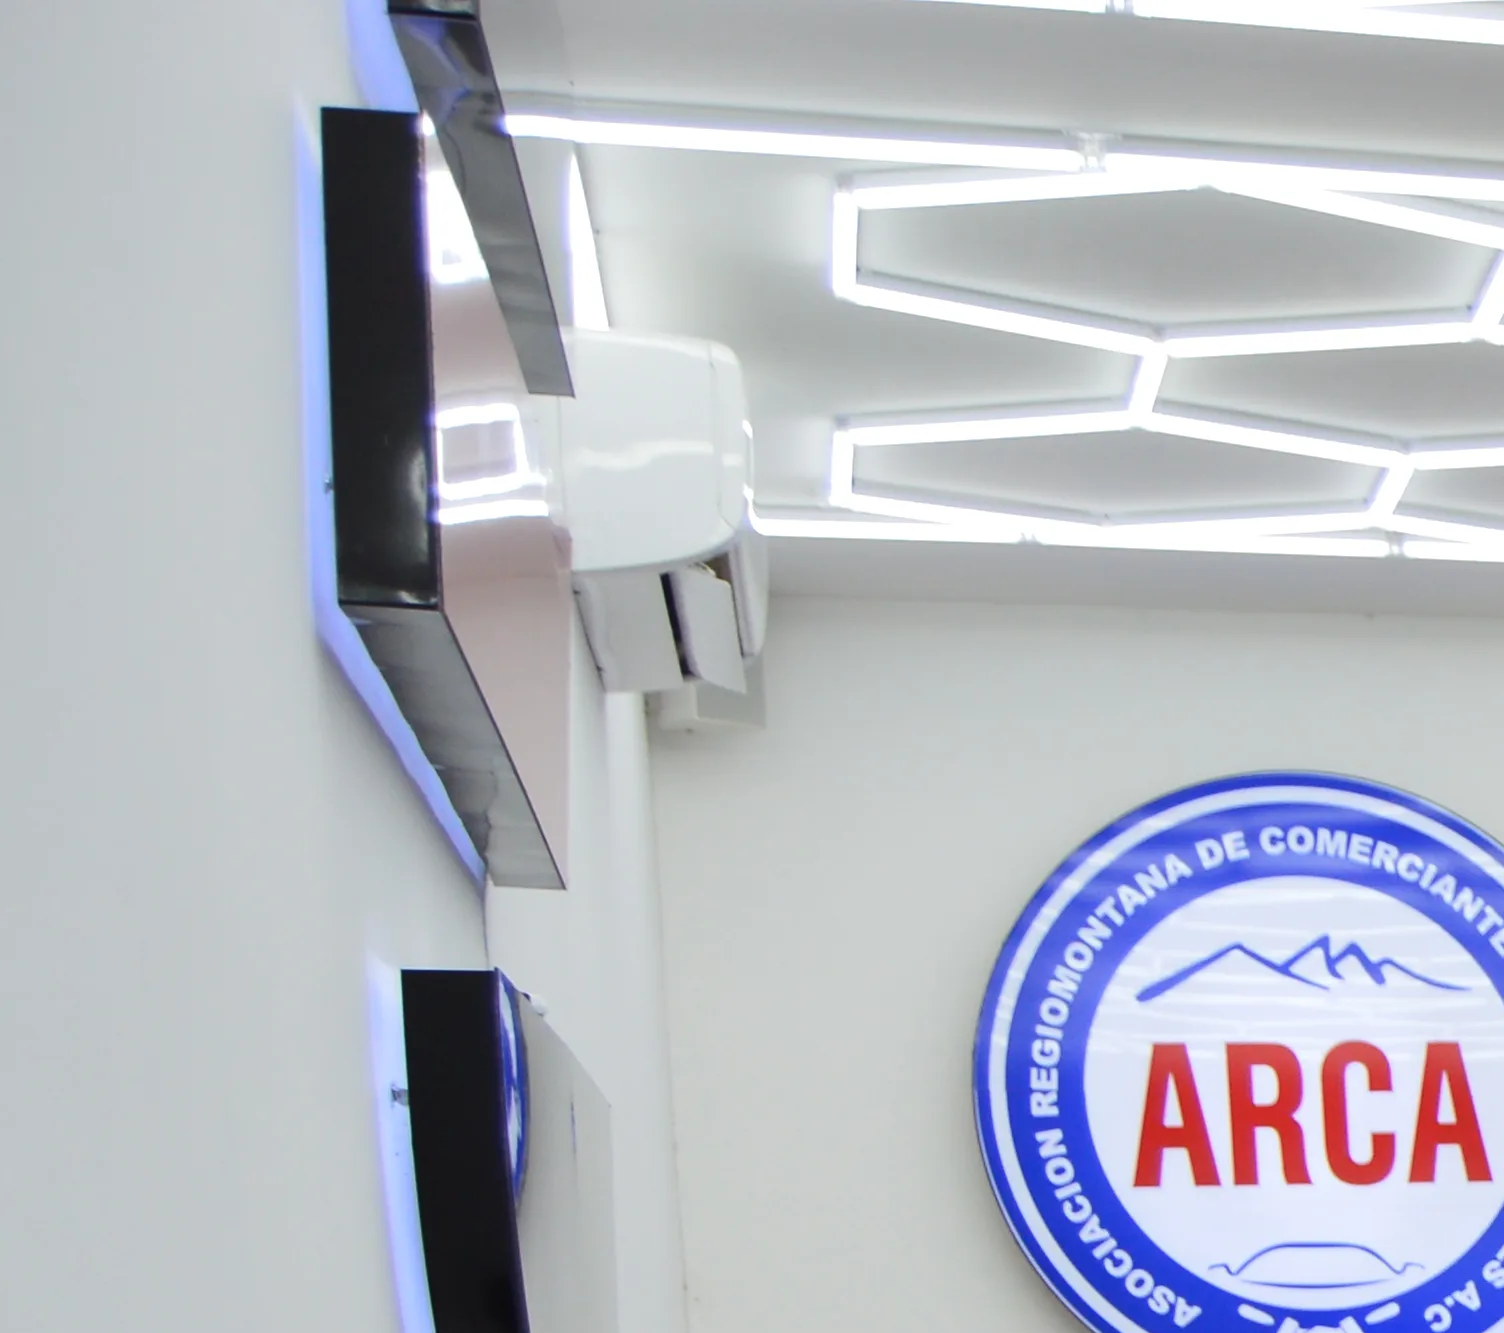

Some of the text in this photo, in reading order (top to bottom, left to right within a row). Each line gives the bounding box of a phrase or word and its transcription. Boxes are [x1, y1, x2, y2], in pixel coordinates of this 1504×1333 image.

[1195, 829, 1251, 870] DE
[1030, 853, 1194, 1117] REGIOMONTANA
[1132, 1040, 1494, 1188] ARCA
[1035, 1128, 1202, 1328] ASOCIACION
